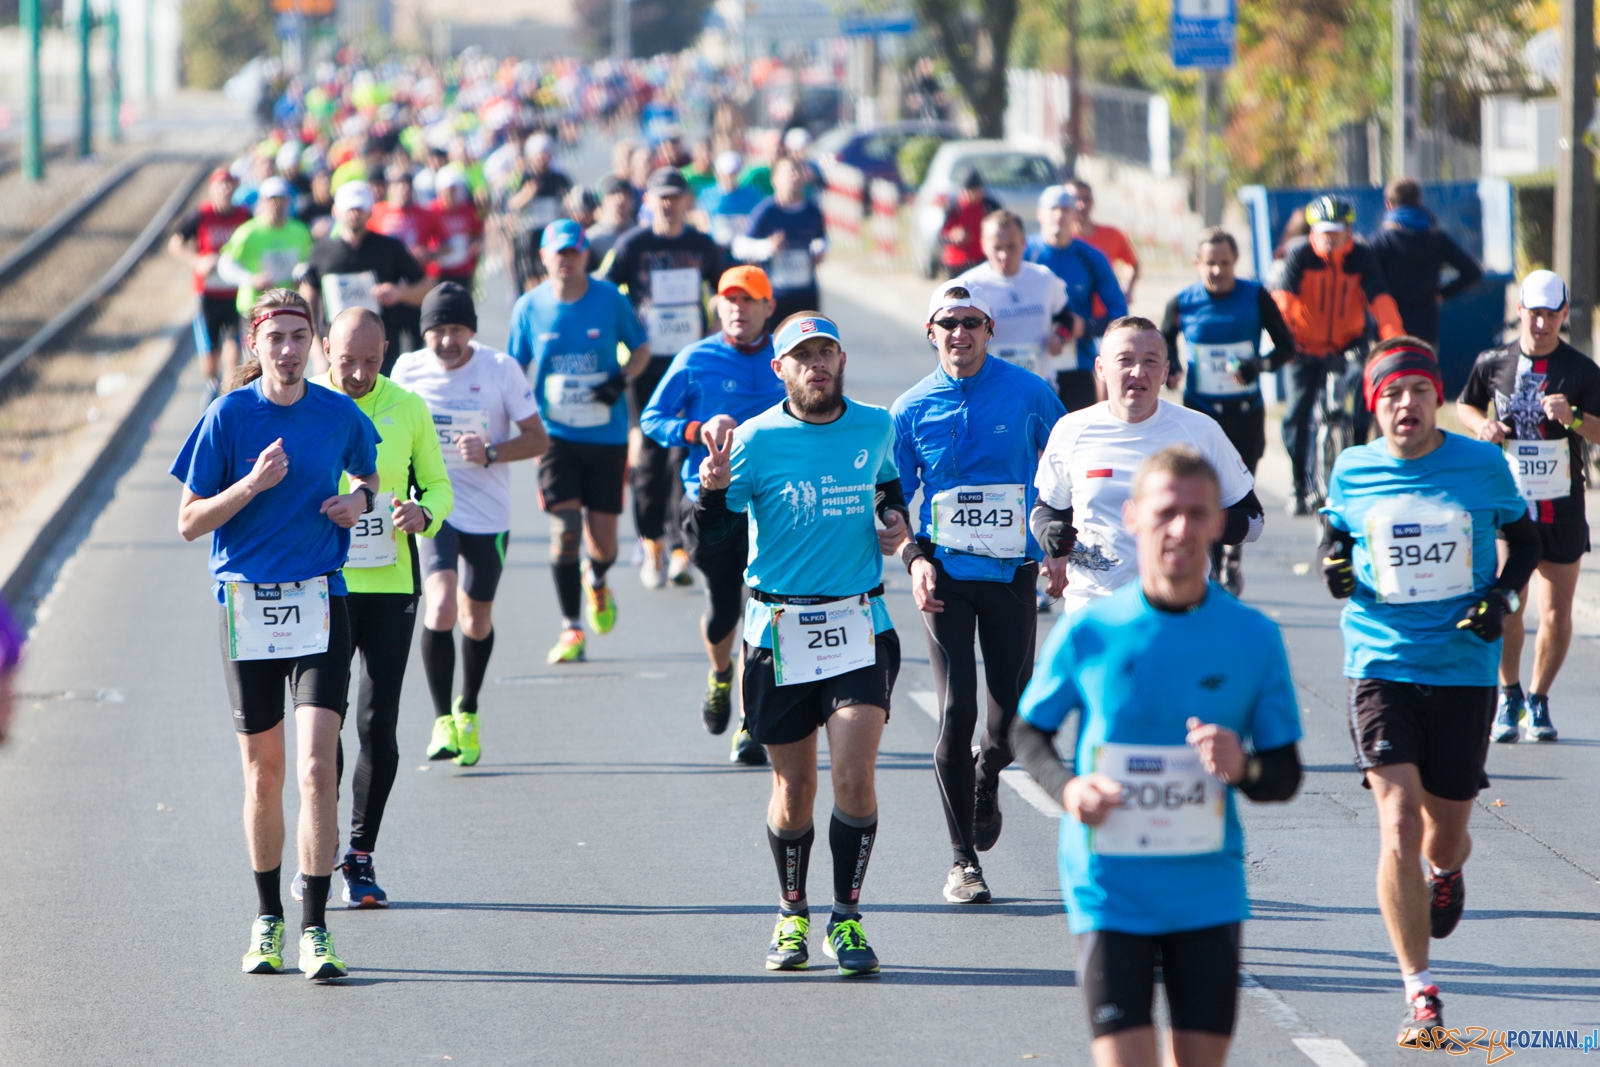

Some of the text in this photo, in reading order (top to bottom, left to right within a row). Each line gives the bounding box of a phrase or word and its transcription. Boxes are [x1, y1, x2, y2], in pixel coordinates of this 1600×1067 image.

[1518, 460, 1558, 475] 3197
[820, 475, 837, 484] 25.
[822, 495, 860, 506] PHILIPS
[845, 505, 865, 515] 2015
[950, 508, 1013, 527] 4843
[1388, 541, 1457, 567] 3947
[263, 605, 300, 625] 571
[807, 626, 847, 649] 261
[816, 653, 842, 661] Bartosz
[1121, 781, 1206, 811] 2064
